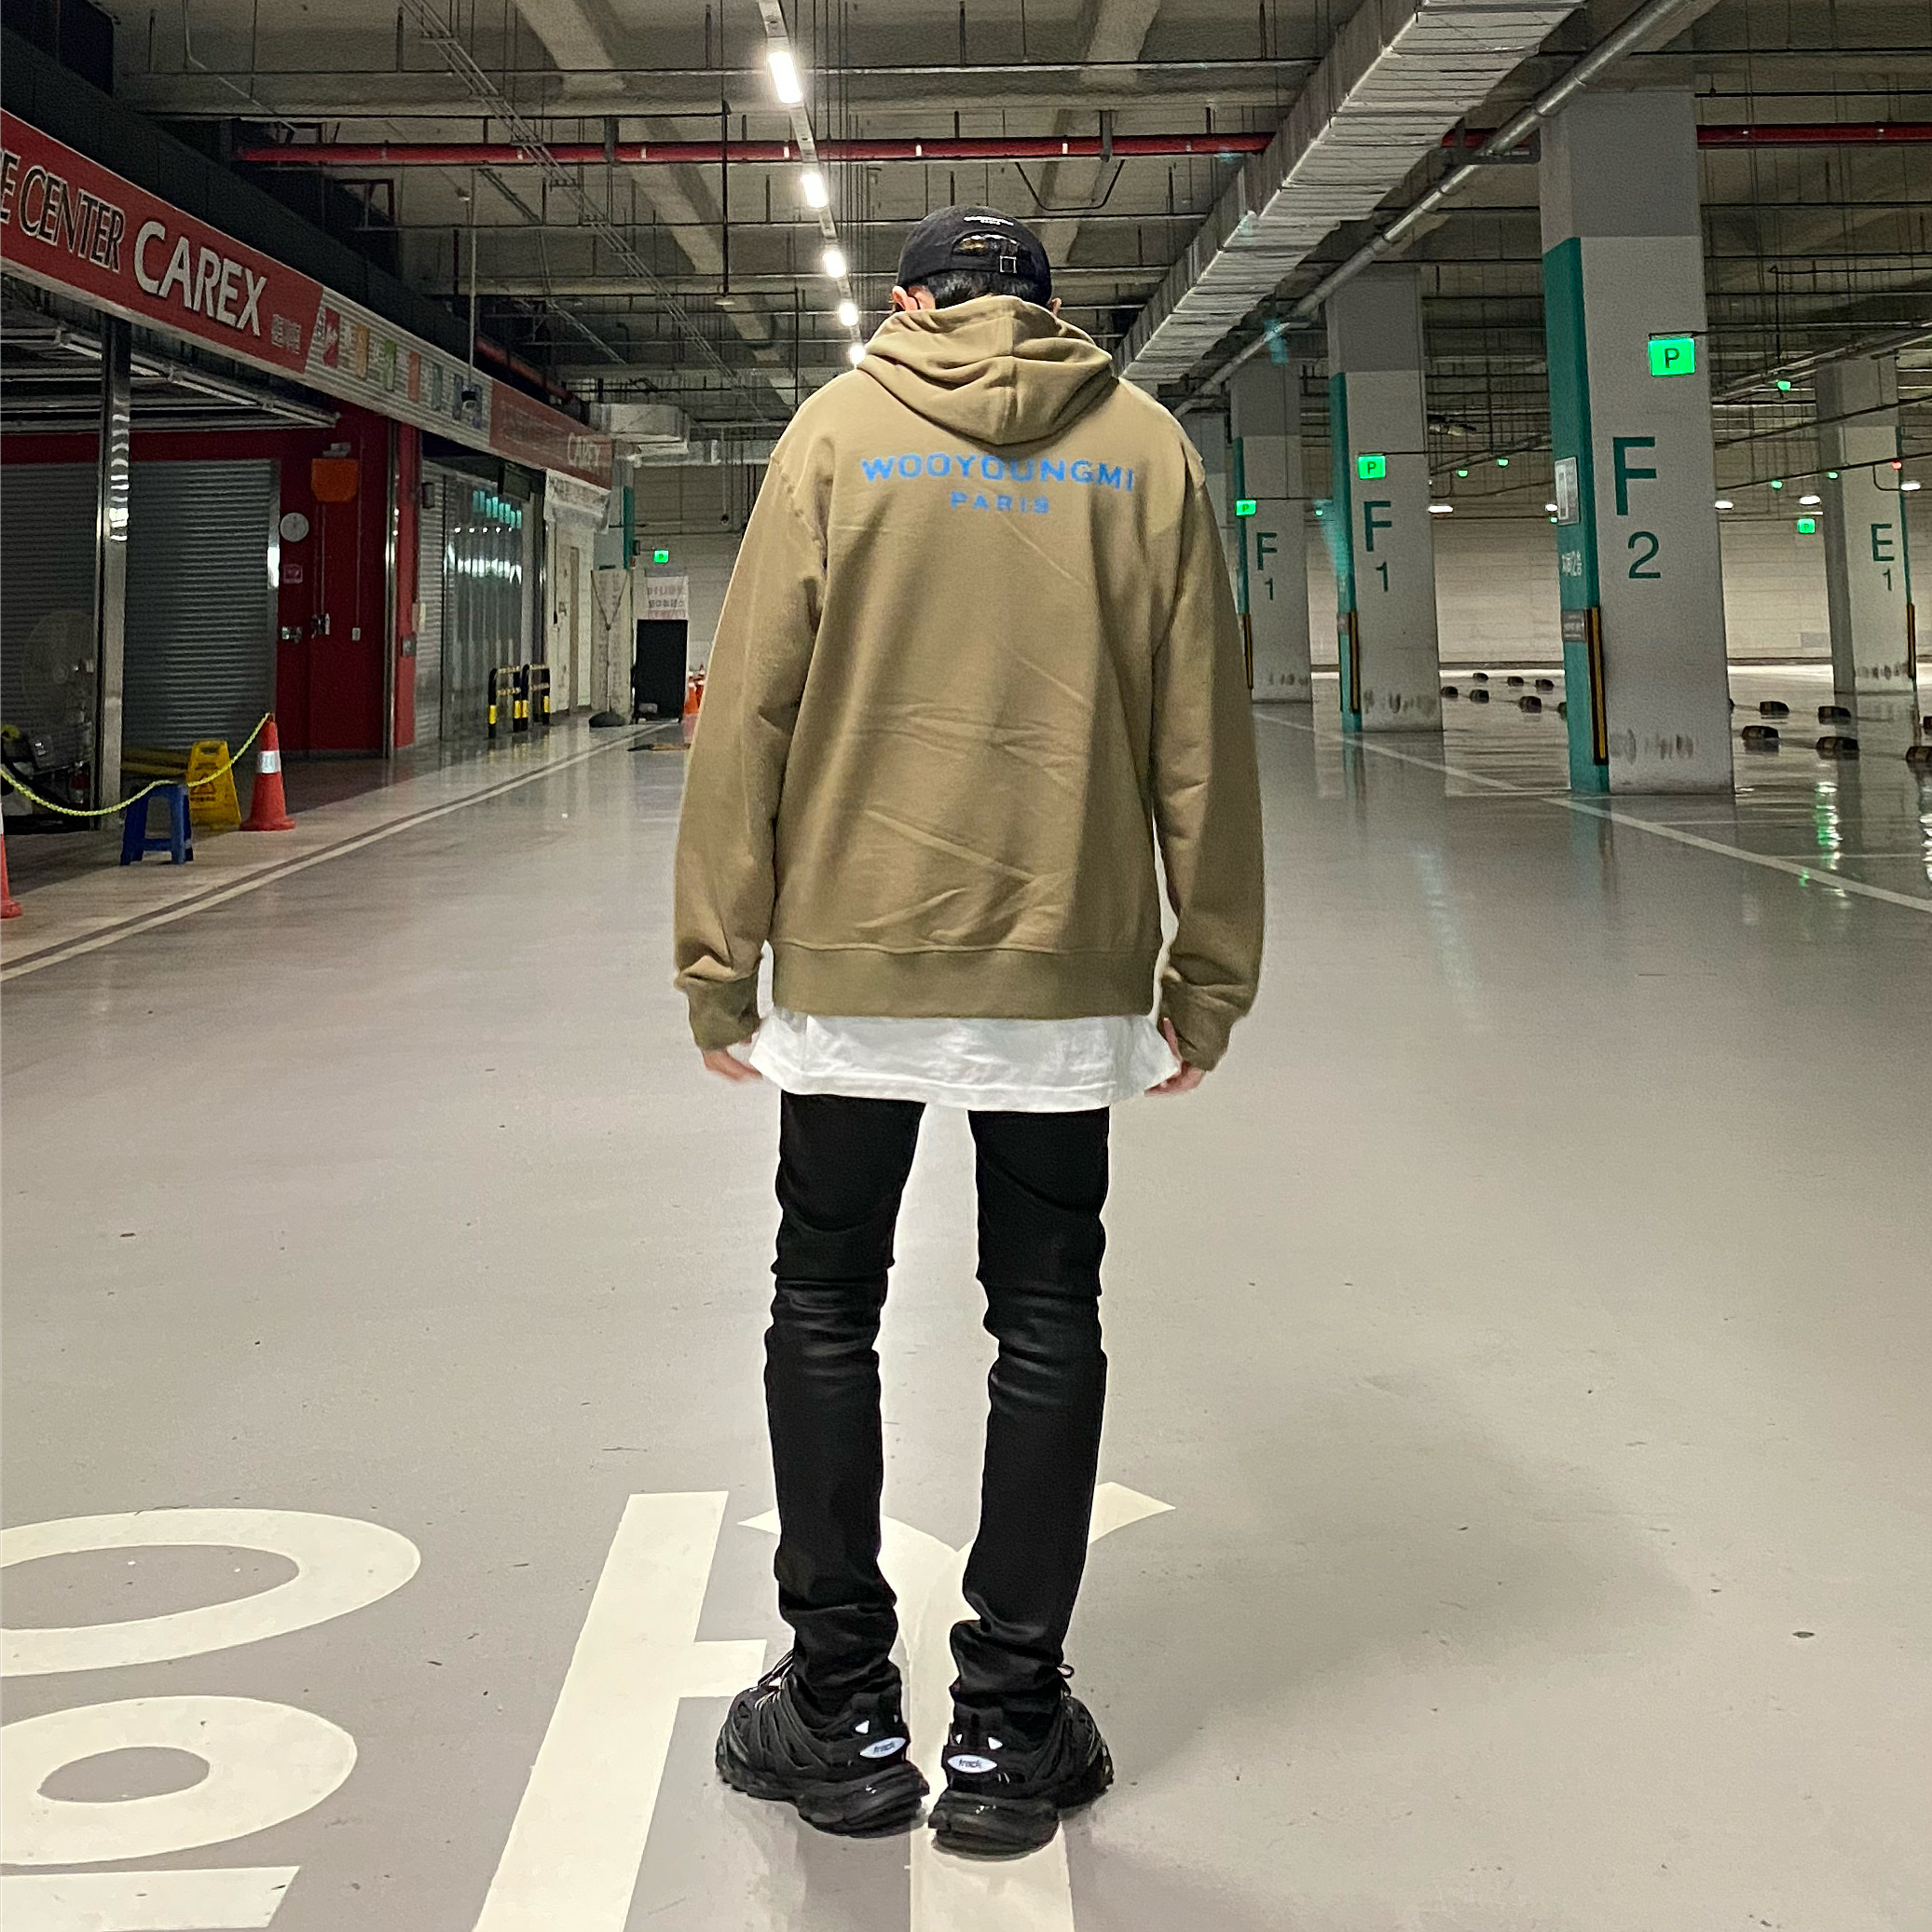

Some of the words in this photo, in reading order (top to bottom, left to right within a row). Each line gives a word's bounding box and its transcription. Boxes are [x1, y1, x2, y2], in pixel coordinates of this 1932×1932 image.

[0, 148, 21, 224] E
[19, 165, 125, 274] CENTER
[134, 221, 267, 336] CAREX
[1665, 348, 1679, 368] P
[861, 452, 1134, 491] WOOYOUNGMI
[1366, 461, 1377, 474] P
[1612, 436, 1657, 515] F
[951, 491, 1049, 514] PARIS
[1363, 500, 1391, 552] F
[1870, 524, 1895, 561] E
[1256, 532, 1278, 570] F
[1627, 530, 1661, 579] 2
[1265, 578, 1274, 600] 1
[1376, 561, 1389, 592] 1
[1883, 569, 1892, 591] 1
